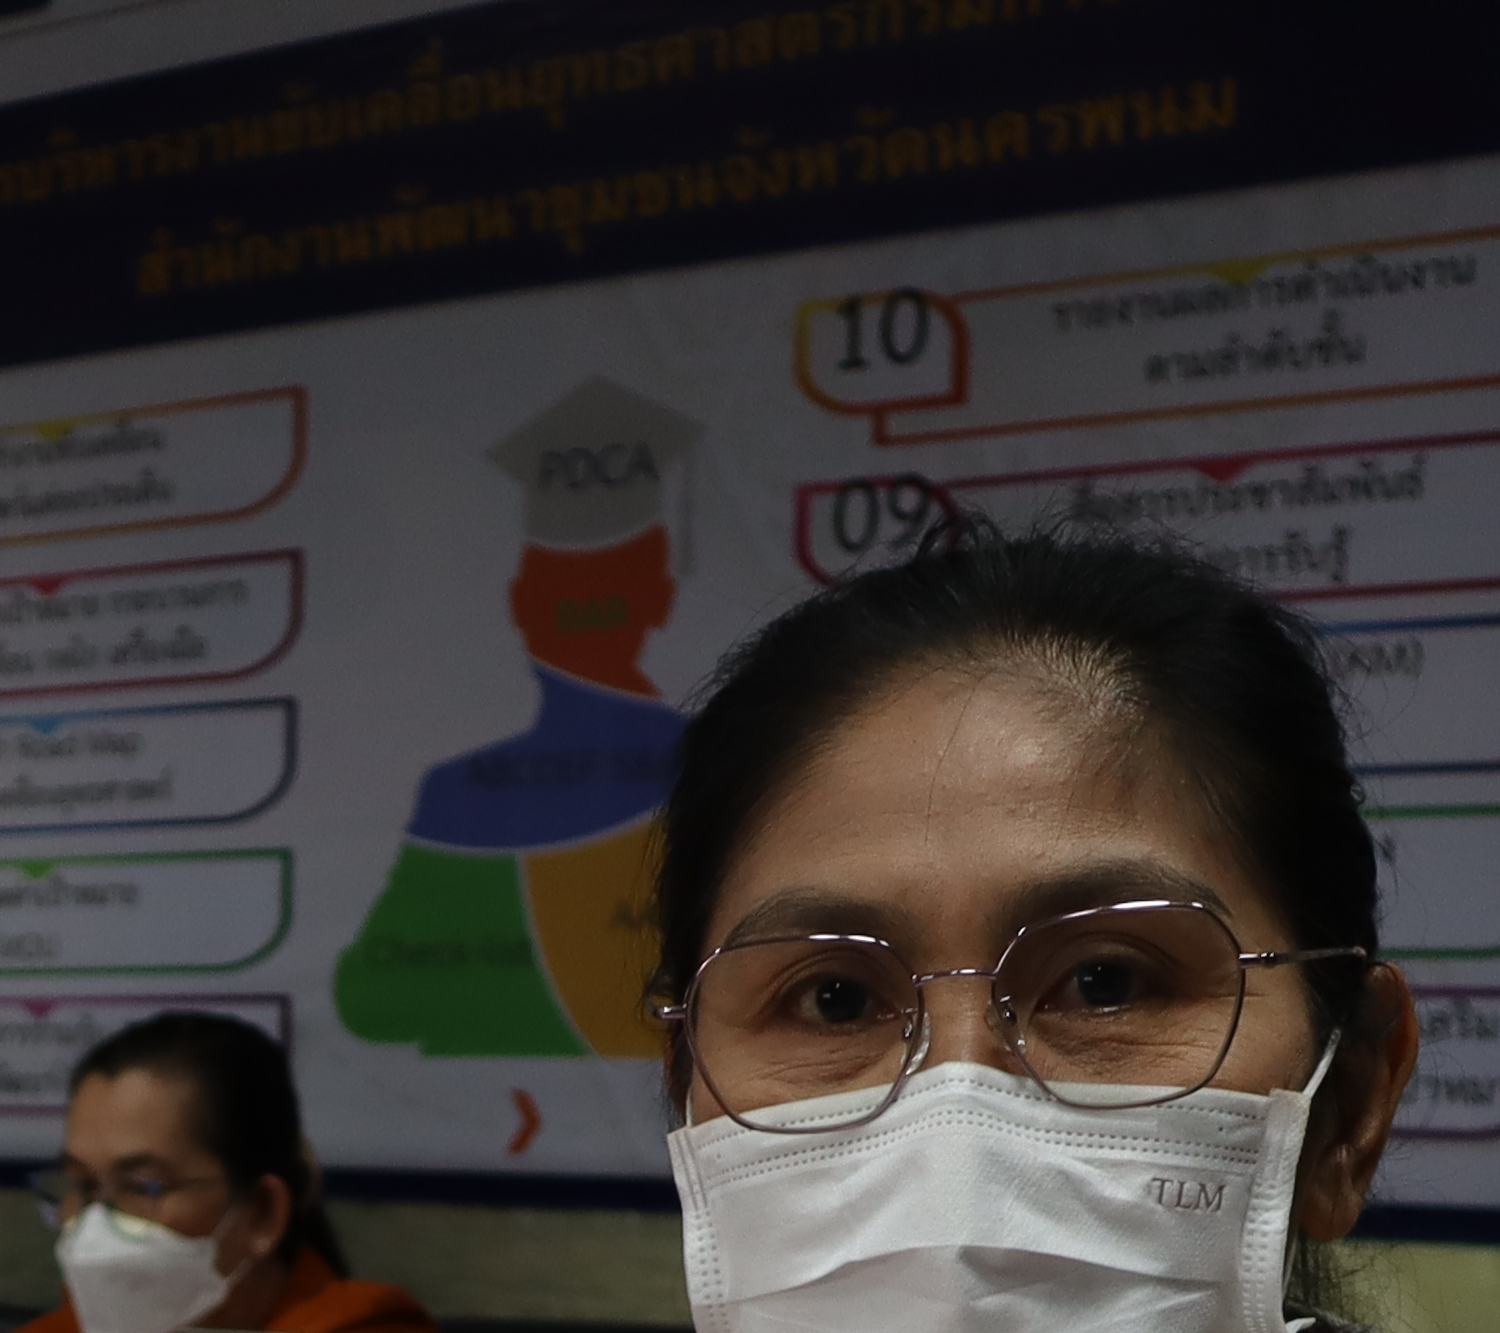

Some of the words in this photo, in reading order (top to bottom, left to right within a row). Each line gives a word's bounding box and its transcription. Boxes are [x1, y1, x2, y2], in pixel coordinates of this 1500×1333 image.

[138, 74, 1239, 298] สำนักงานพัฒนาชุมชนจังหวัดนครพนม
[835, 288, 931, 371] 10
[537, 440, 661, 491] PDCA
[831, 473, 931, 552] 09
[1151, 1177, 1226, 1212] TLM
